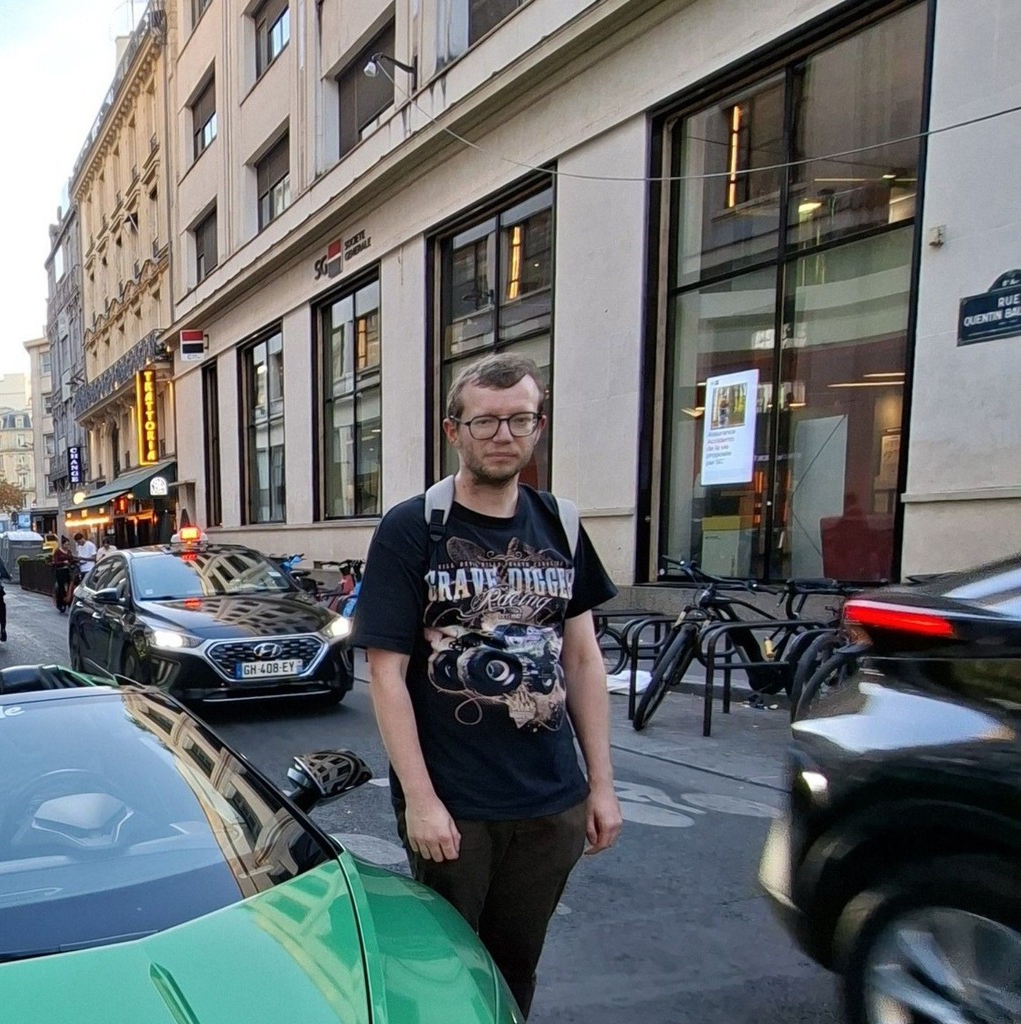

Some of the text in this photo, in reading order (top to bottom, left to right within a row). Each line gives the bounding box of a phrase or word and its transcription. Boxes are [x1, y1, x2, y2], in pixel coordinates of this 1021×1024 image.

[314, 255, 327, 280] SG
[998, 294, 1021, 307] RUE
[963, 310, 1003, 327] QUENTIN
[144, 371, 156, 460] TRATTORIA
[70, 447, 79, 482] CHANGE
[424, 567, 497, 602] GRAVE
[470, 588, 554, 620] Racing
[243, 661, 295, 675] GH-408-EY
